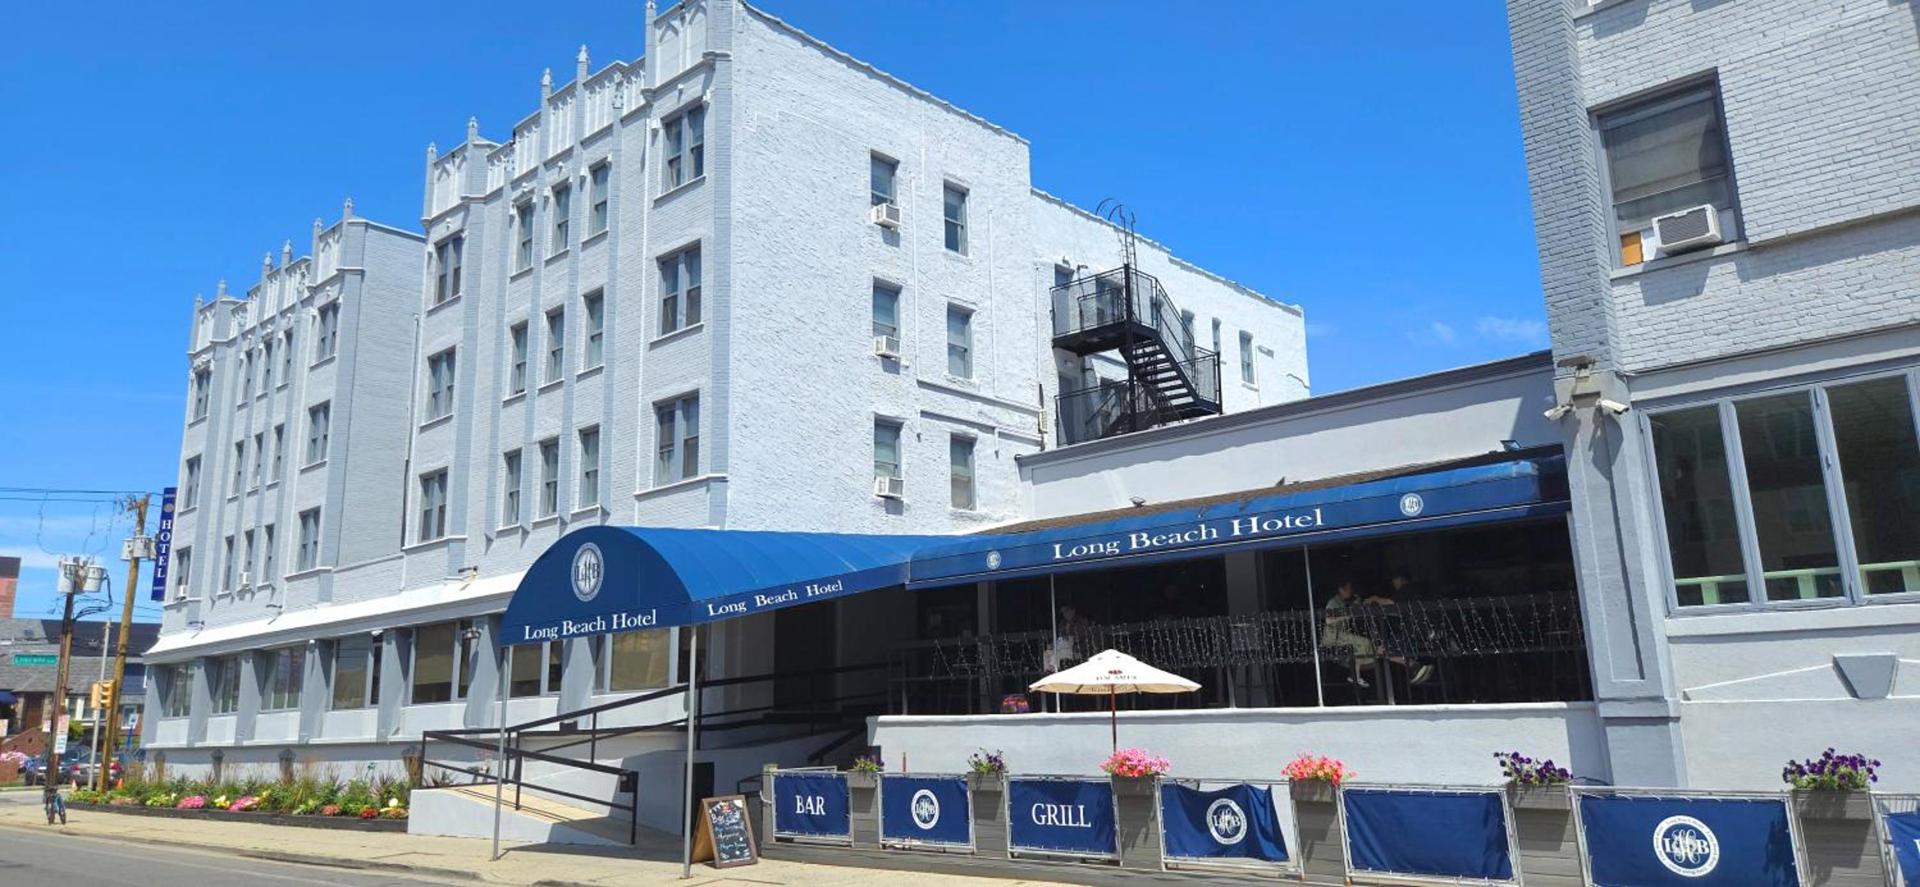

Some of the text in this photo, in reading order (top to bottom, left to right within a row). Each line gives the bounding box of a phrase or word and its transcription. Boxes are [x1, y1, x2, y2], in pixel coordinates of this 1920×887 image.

[157, 519, 172, 578] HOTEL
[1053, 508, 1324, 560] Long Beach Hotel
[707, 580, 844, 617] Long Beach Hotel
[524, 608, 657, 641] Long Beach Hotel
[794, 794, 827, 816] BAR
[1031, 802, 1092, 828] GRILL
